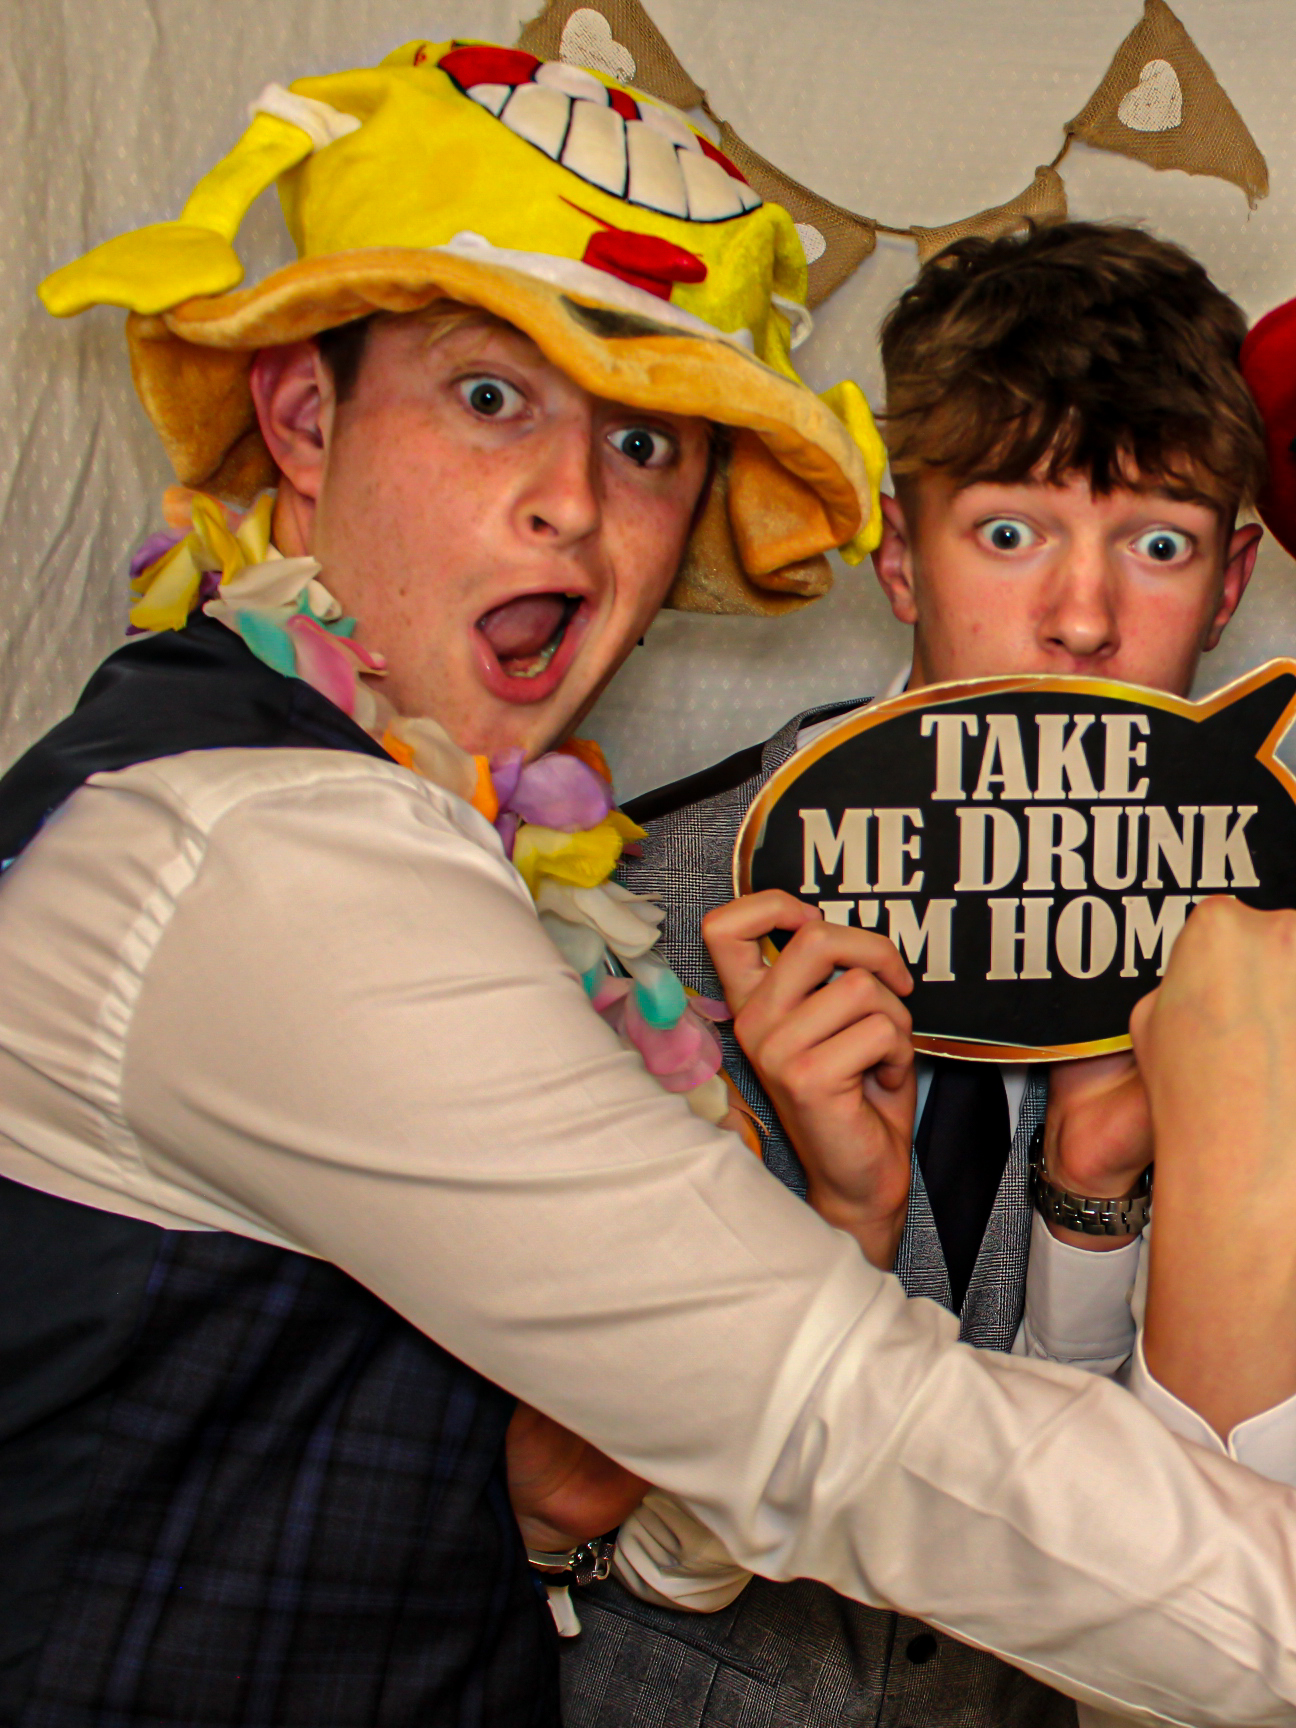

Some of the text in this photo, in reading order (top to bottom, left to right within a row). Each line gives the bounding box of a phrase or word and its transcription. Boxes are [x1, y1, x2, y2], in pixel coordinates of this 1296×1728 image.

[920, 713, 1151, 801] TAKE
[798, 805, 1261, 894] ME DRUNK
[985, 894, 1237, 981] HOM
